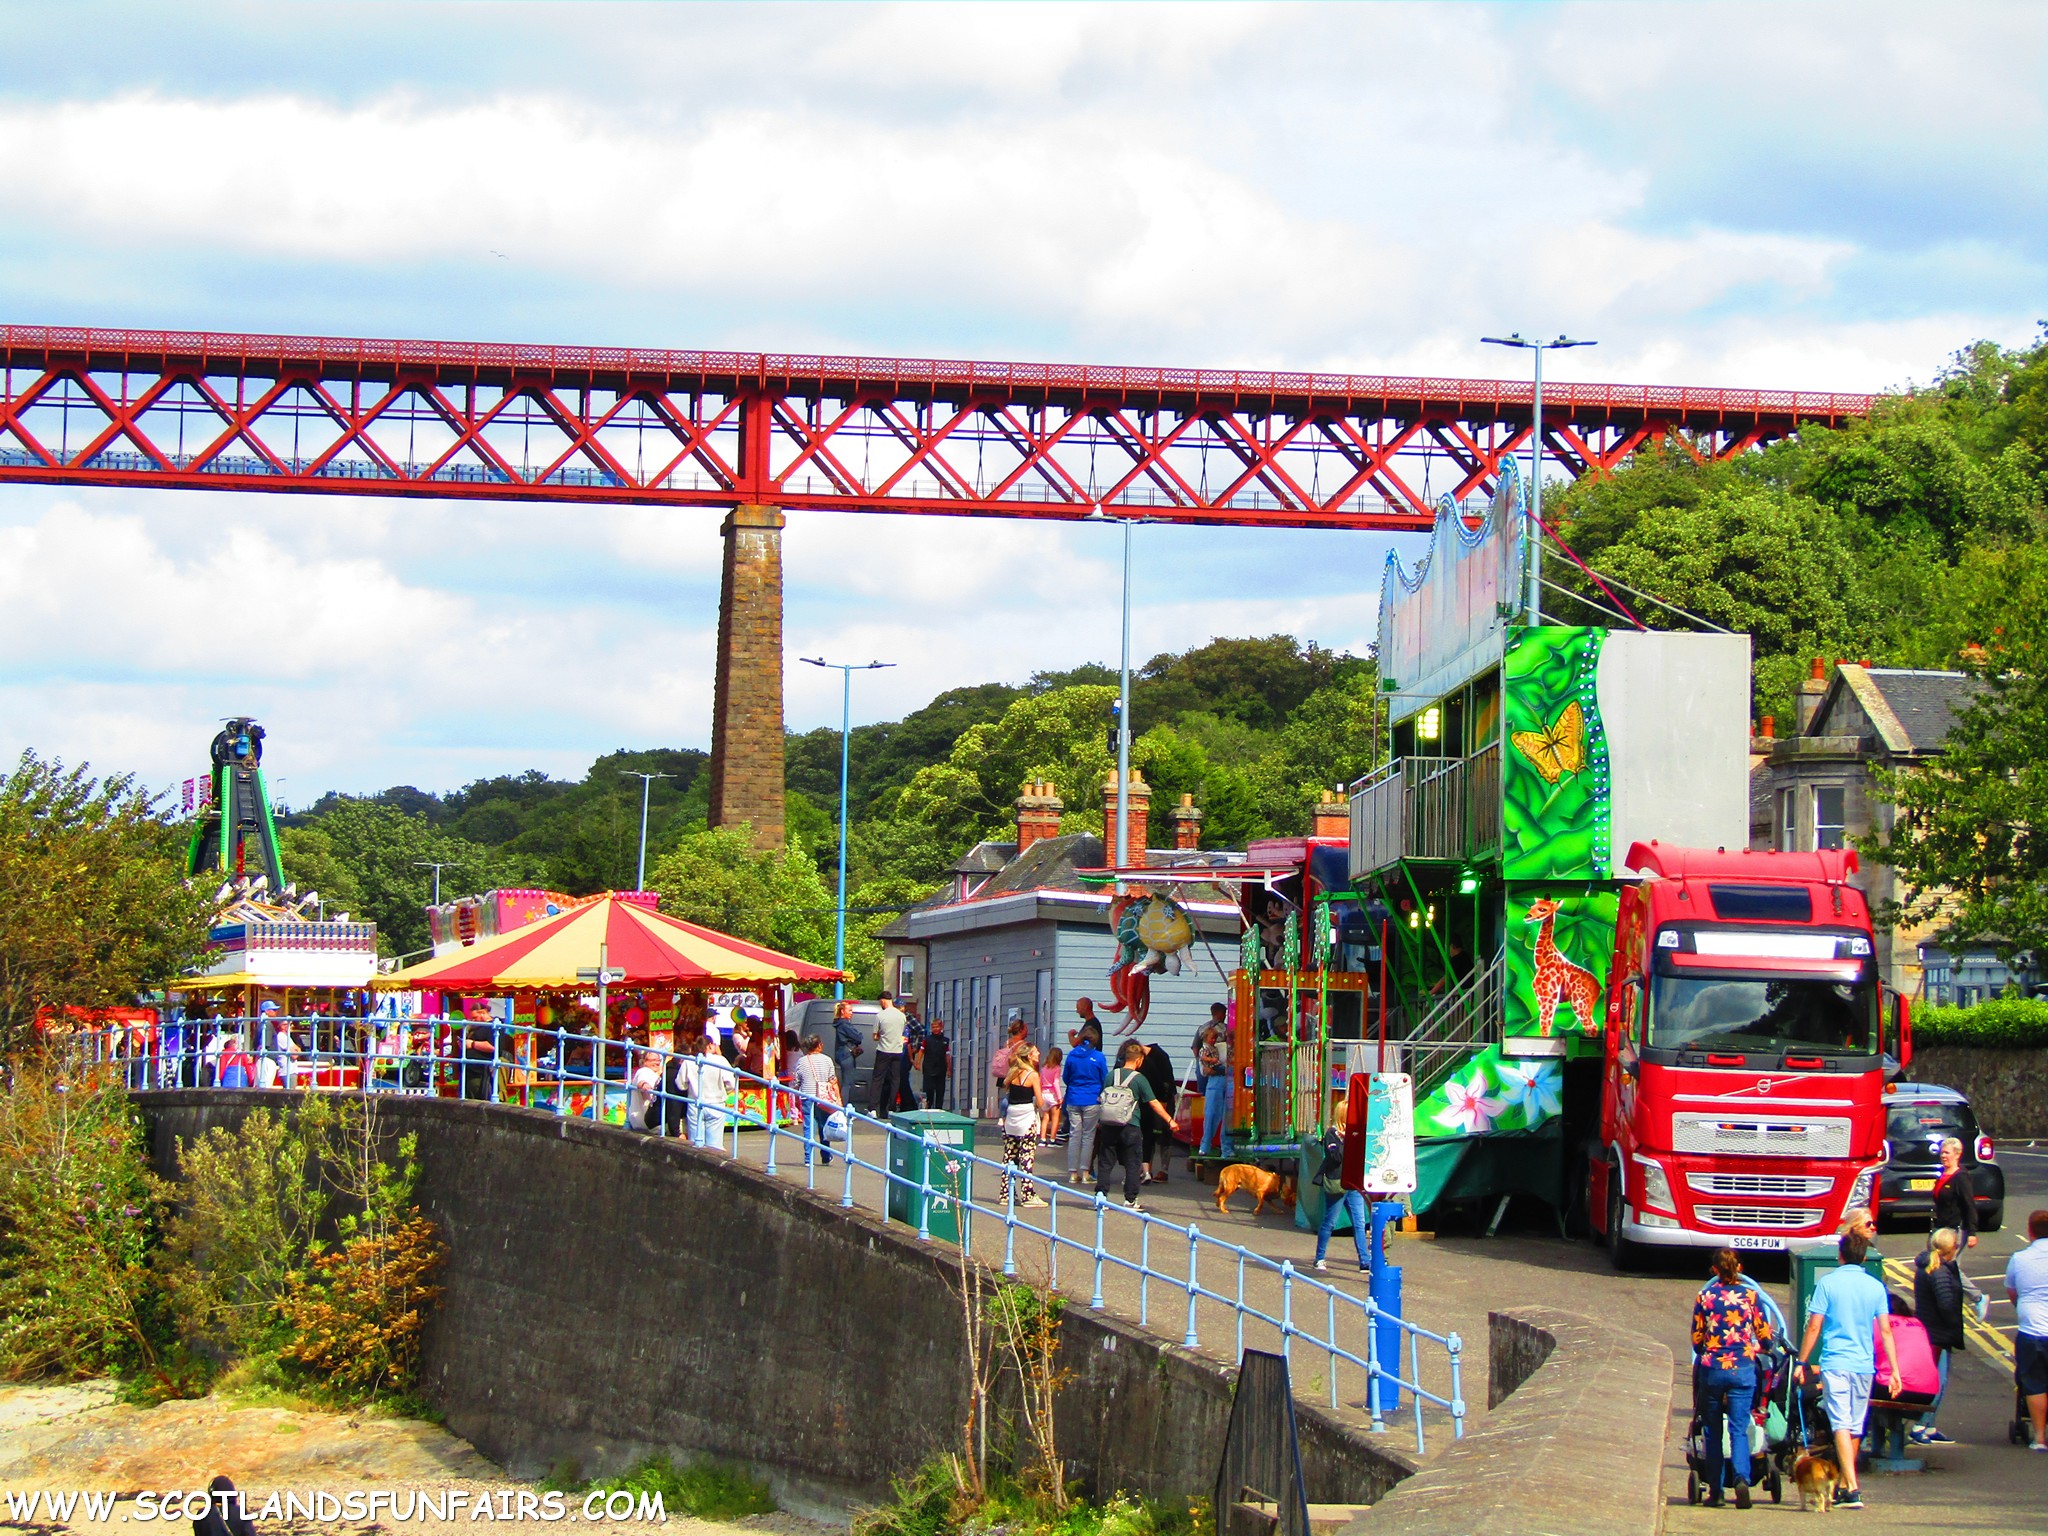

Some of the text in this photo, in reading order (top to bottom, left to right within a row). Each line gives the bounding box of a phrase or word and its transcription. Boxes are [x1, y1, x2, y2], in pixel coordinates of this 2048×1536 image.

[649, 1010, 672, 1020] DUCK
[649, 1020, 673, 1031] GAME
[1734, 1237, 1759, 1247] SC64
